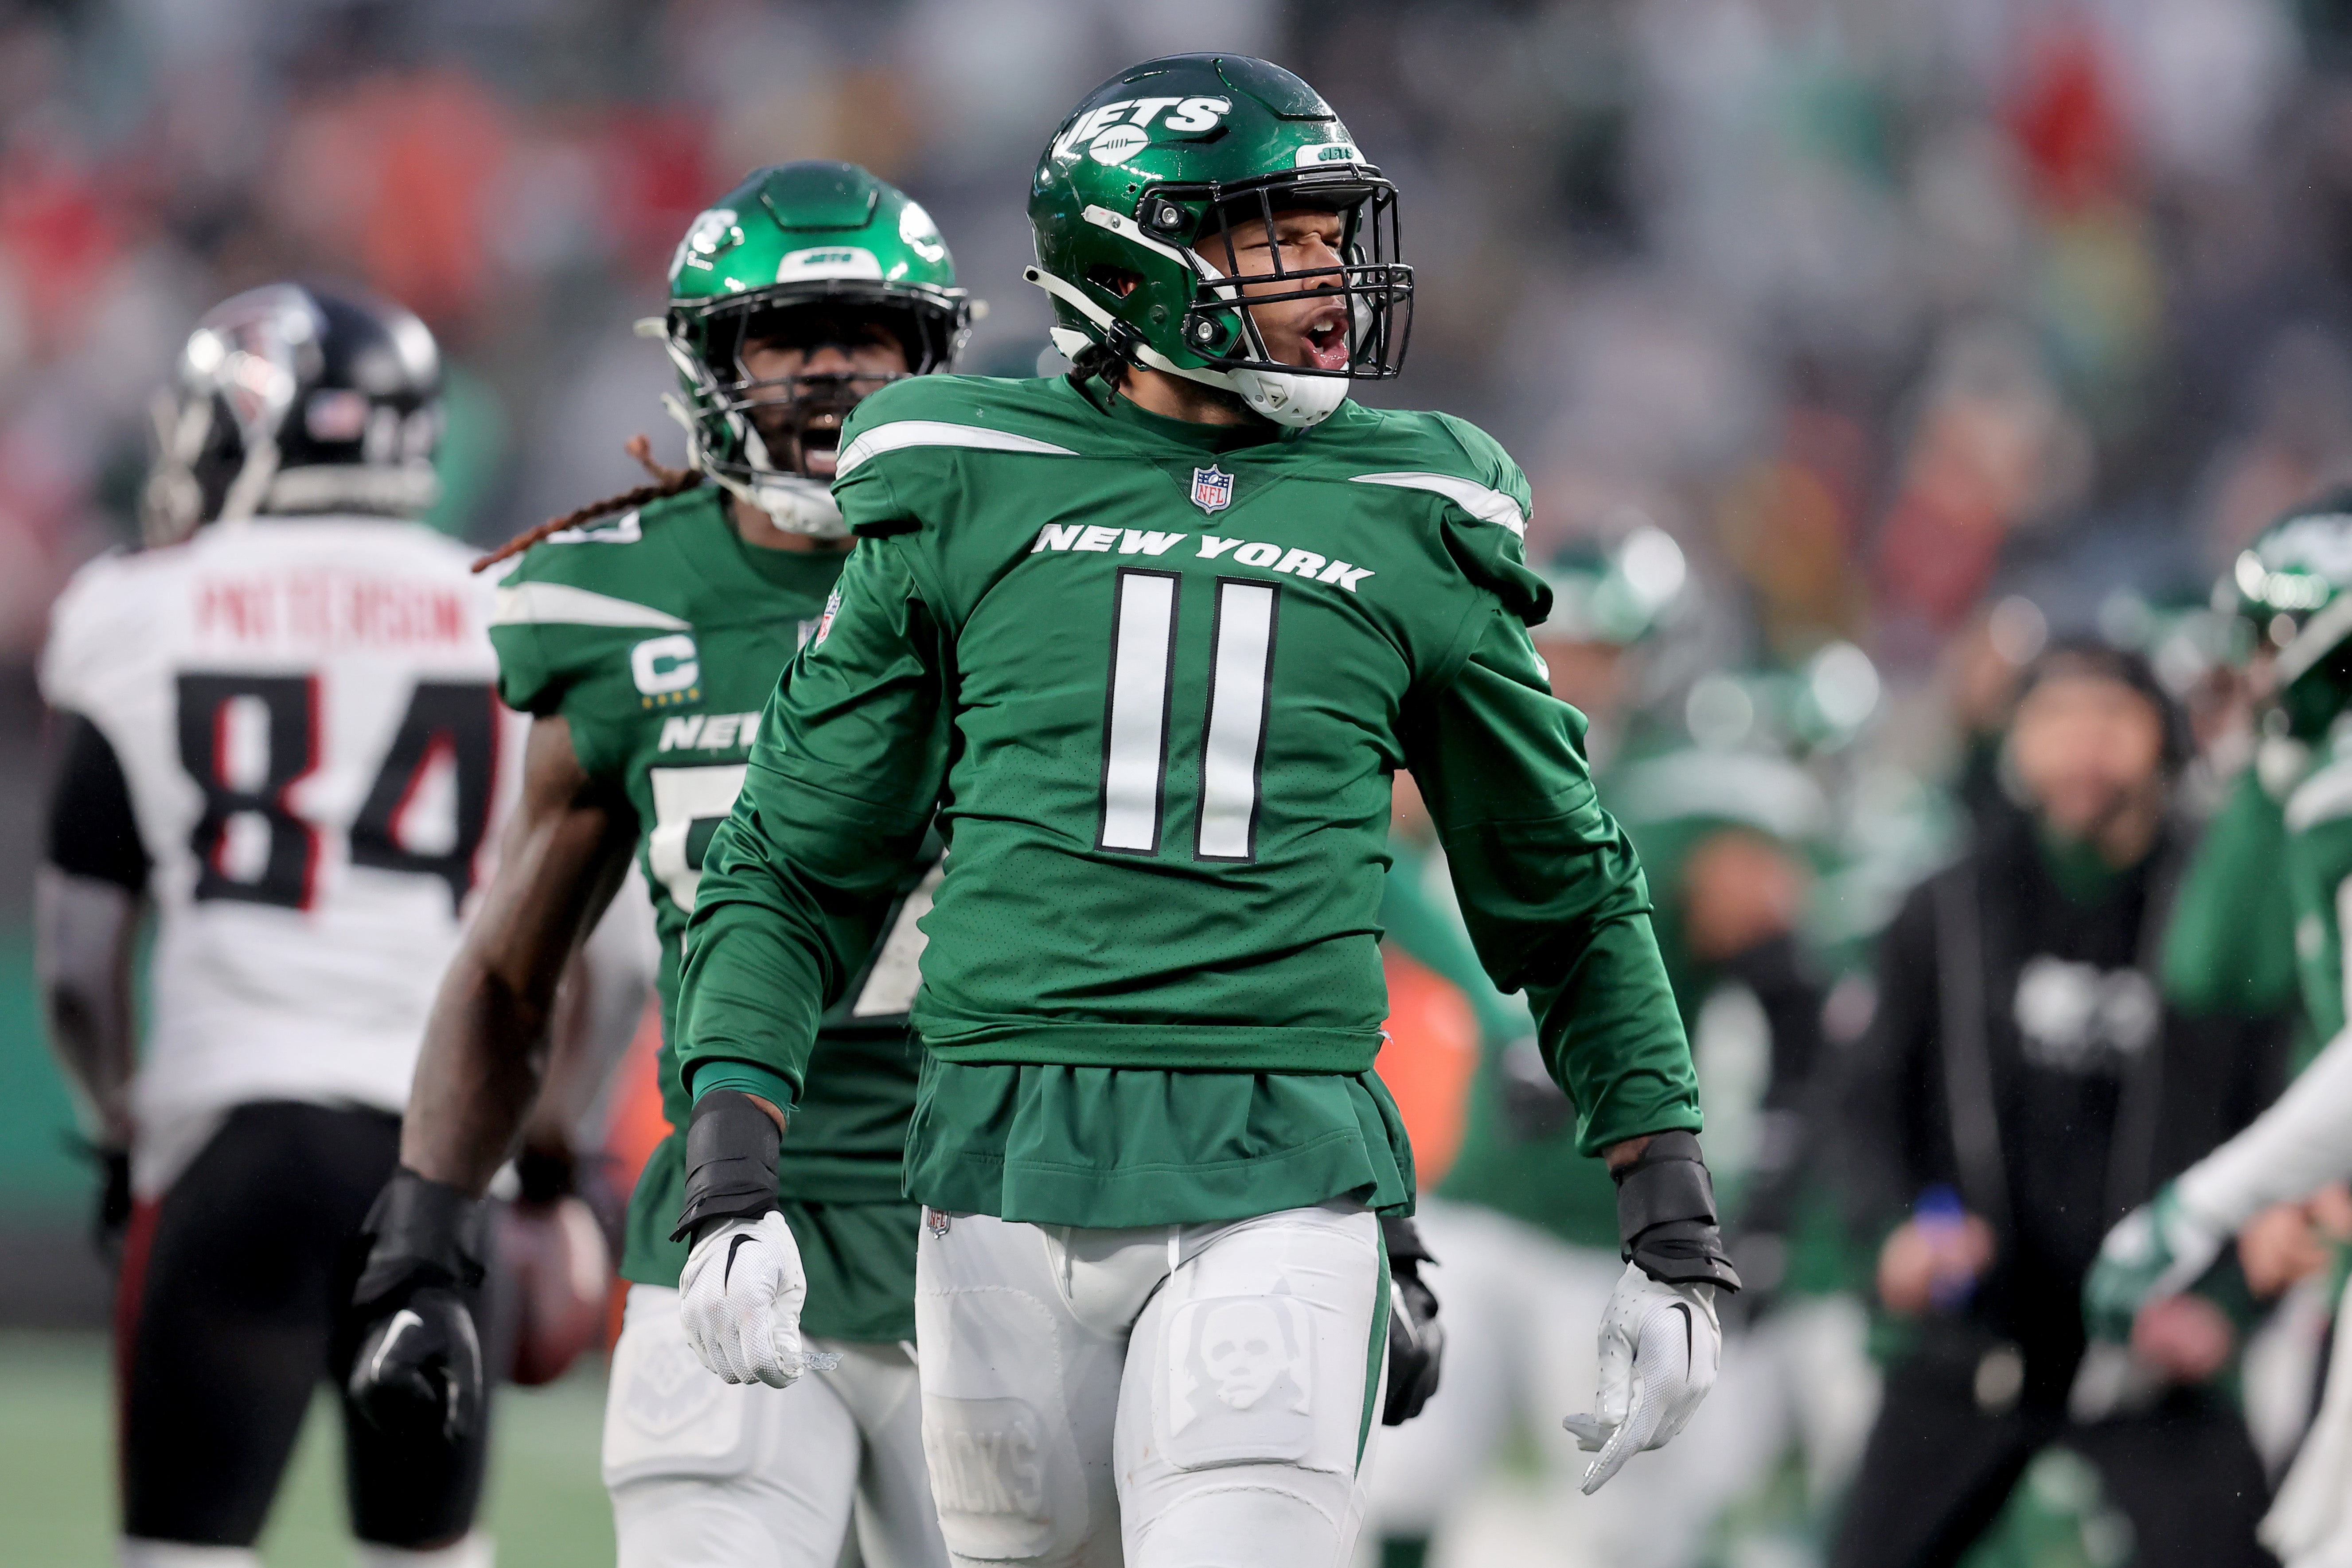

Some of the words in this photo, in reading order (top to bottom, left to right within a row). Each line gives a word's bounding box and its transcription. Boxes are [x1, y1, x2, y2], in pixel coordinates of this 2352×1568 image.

[1052, 96, 1233, 160] JETS
[1318, 146, 1354, 161] JETS
[1198, 484, 1224, 504] NFL
[1031, 523, 1189, 556] NEW
[1195, 534, 1376, 593] YORK
[631, 634, 699, 694] C
[1094, 566, 1282, 864] 11
[175, 671, 501, 918] 84
